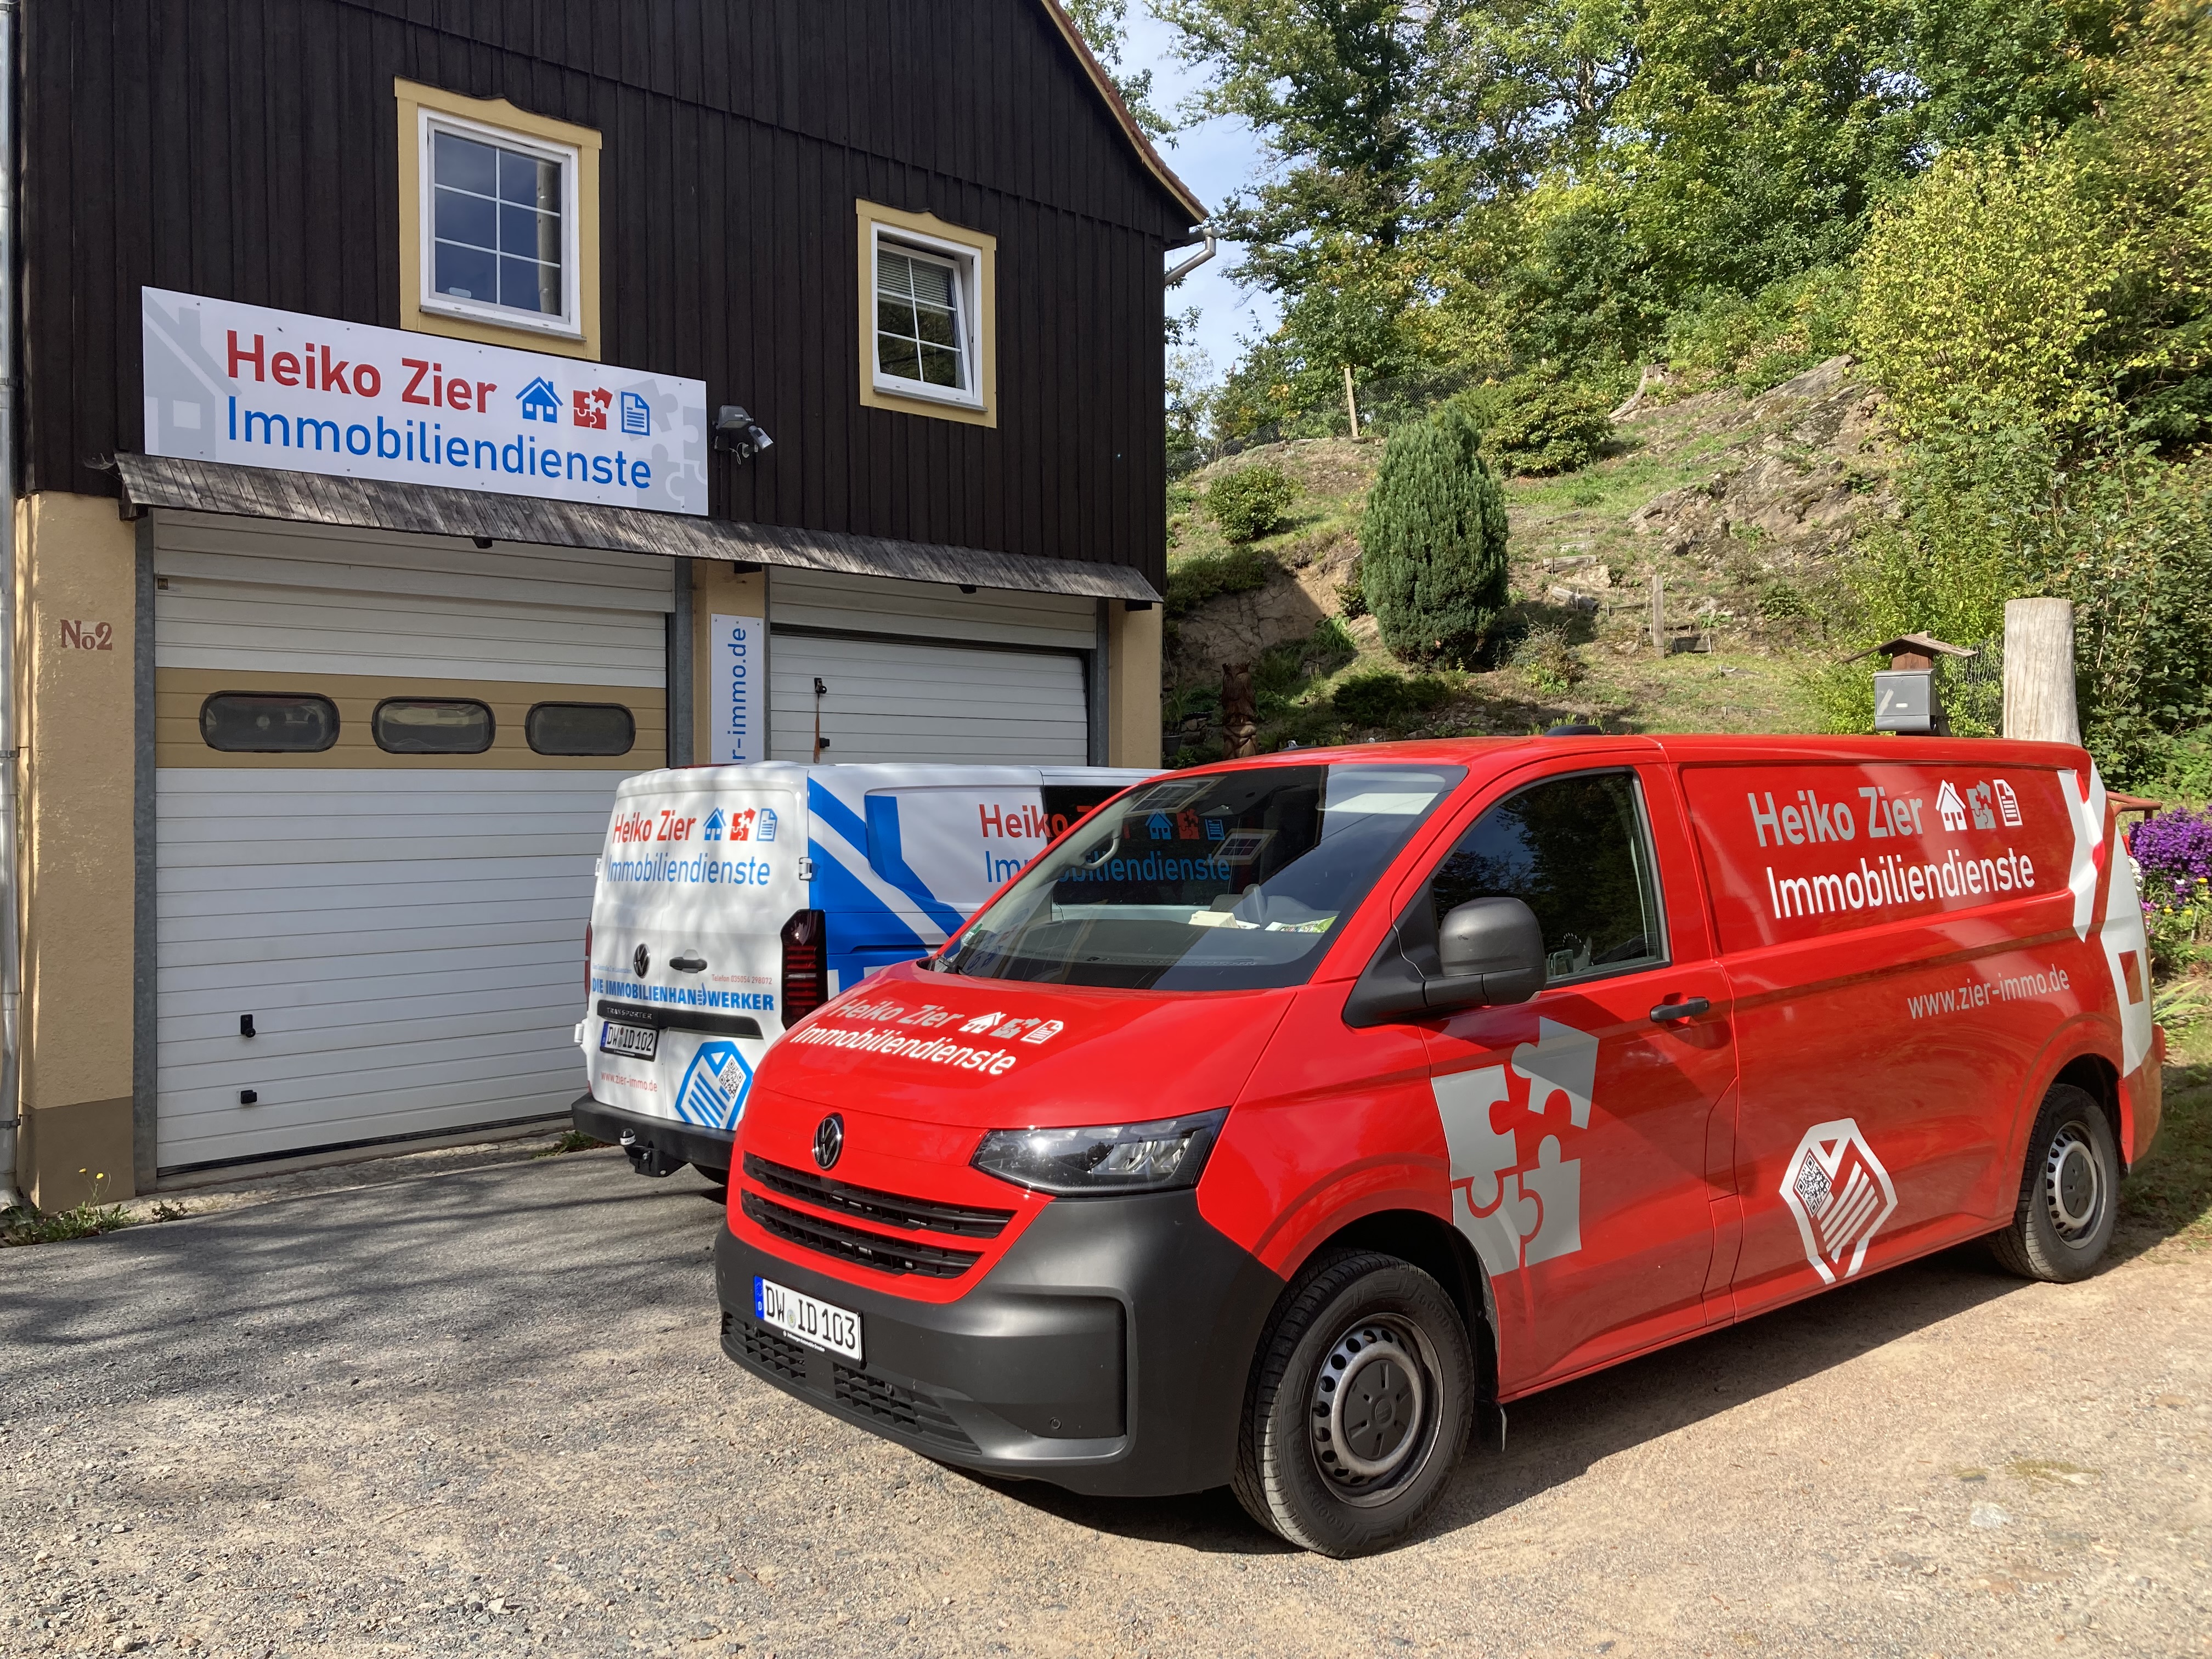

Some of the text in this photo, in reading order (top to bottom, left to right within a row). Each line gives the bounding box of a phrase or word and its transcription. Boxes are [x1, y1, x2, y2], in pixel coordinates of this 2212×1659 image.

[227, 329, 498, 413] Heiko Zier
[228, 395, 652, 489] Immobiliendienste
[612, 810, 697, 844] Heiko Zier
[979, 804, 1068, 838] Heiko
[1748, 786, 1923, 847] Heiko Zier
[607, 853, 770, 885] Immobiliendienste
[1766, 848, 2035, 918] Immobiliendienste
[592, 978, 603, 993] DIE
[731, 975, 750, 984] 035054
[752, 976, 772, 985] 298072
[1908, 963, 2070, 1020] www.zier-immo.de
[606, 1006, 653, 1020] TRANSPORTER
[827, 999, 965, 1029] Heiko Zier
[607, 1026, 620, 1047] DW
[789, 1022, 1017, 1075] Immobiliendienste
[601, 1071, 658, 1092] www.zier-immo.de
[765, 1285, 785, 1323] DW
